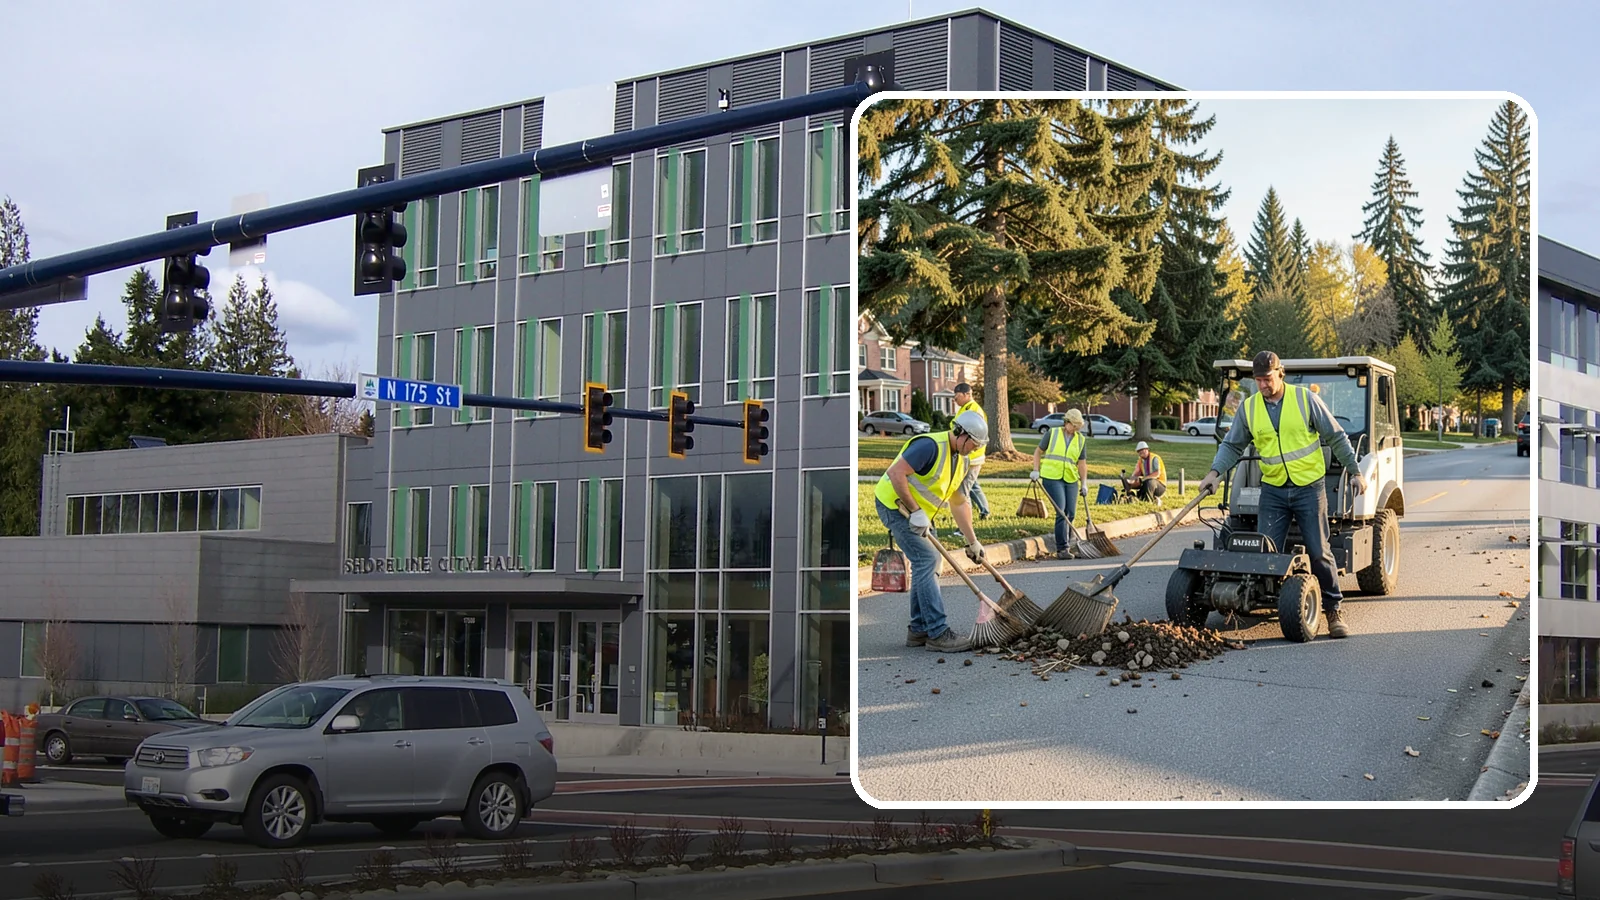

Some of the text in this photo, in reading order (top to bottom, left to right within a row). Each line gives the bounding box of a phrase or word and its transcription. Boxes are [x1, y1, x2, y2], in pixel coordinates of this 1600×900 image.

[387, 380, 451, 406] N 175 St
[344, 555, 526, 574] SHORELINE CITY HALL
